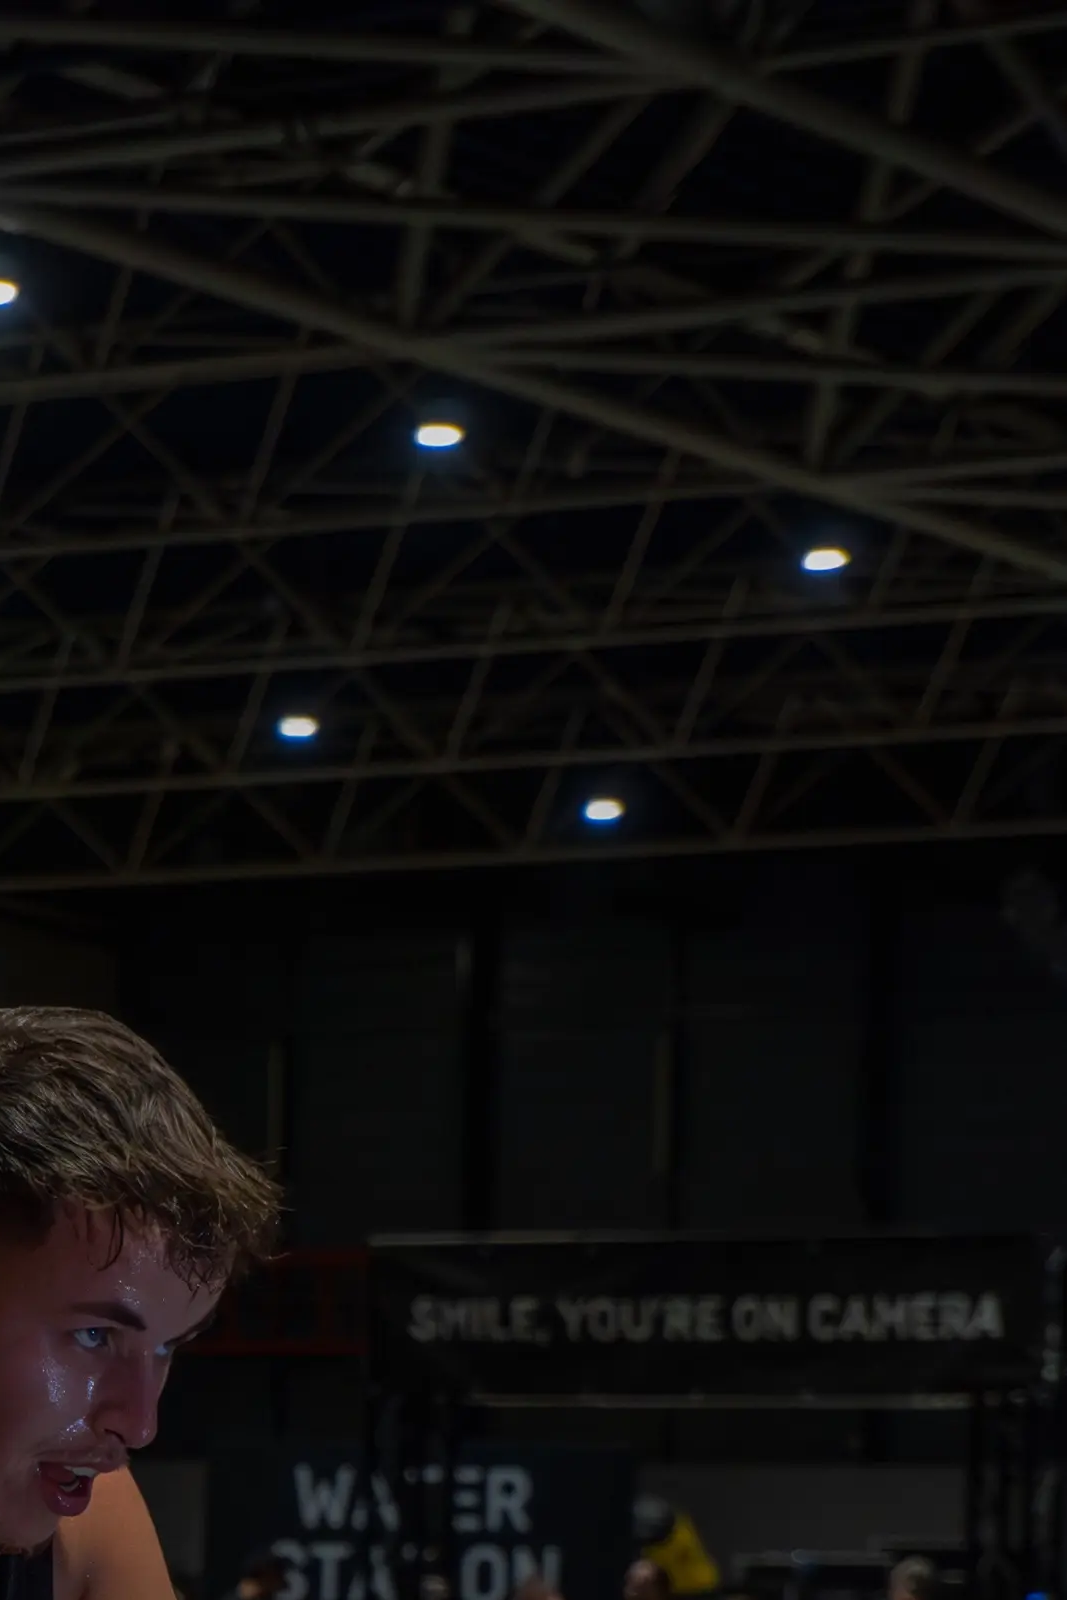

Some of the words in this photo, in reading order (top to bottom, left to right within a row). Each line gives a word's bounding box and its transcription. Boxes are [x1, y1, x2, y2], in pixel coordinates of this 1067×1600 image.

[556, 1294, 725, 1342] YOU'RE
[733, 1294, 801, 1342] ON
[807, 1292, 1004, 1342] CAMERA
